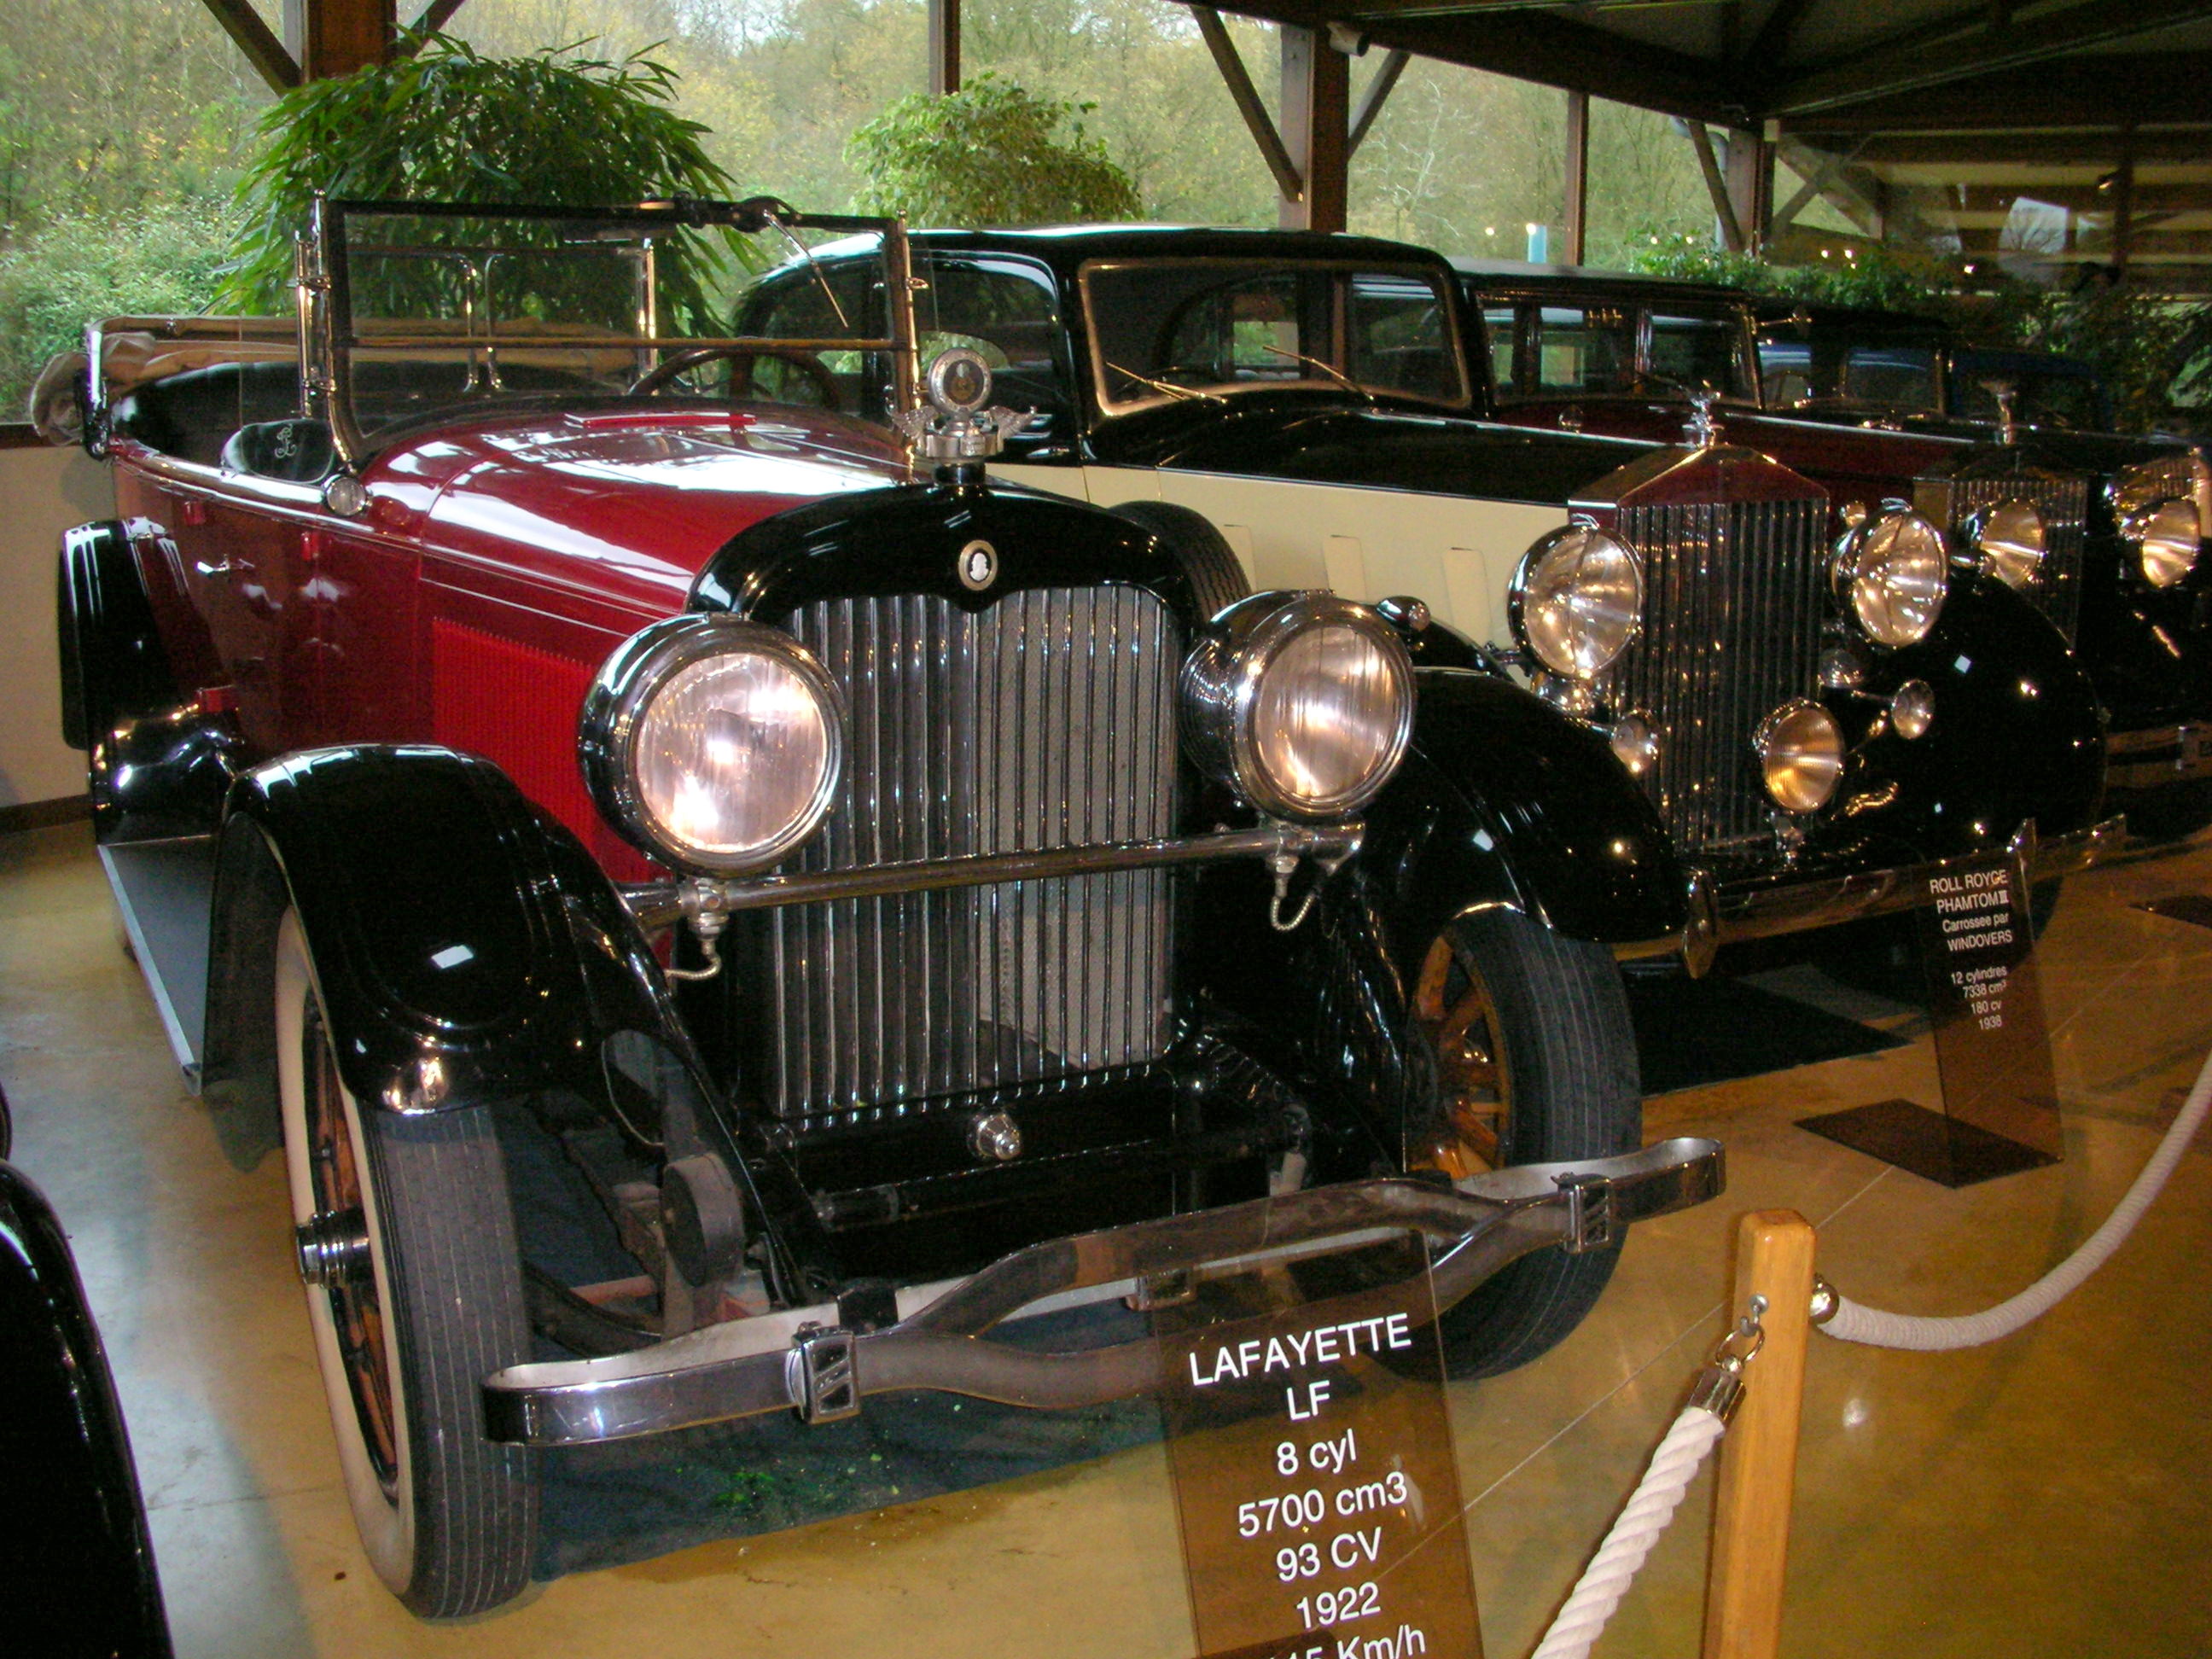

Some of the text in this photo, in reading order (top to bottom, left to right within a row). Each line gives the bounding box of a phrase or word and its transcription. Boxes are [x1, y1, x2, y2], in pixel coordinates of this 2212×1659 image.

[1930, 869, 2008, 894] ROLL ROYCE
[1993, 912, 2009, 927] par
[1947, 929, 2013, 952] WINDOVERS
[1951, 966, 2007, 984] 12 cylindres
[1971, 1001, 1988, 1014] 180
[1190, 1313, 1412, 1387] LAFAYETTE
[1286, 1380, 1330, 1421] LF
[1277, 1428, 1357, 1476] 8 cyl
[1238, 1471, 1407, 1538] 5700 cm3
[1277, 1527, 1382, 1581] 93 CV
[1296, 1581, 1381, 1628] 1922
[1336, 1624, 1426, 1659] Km/h
